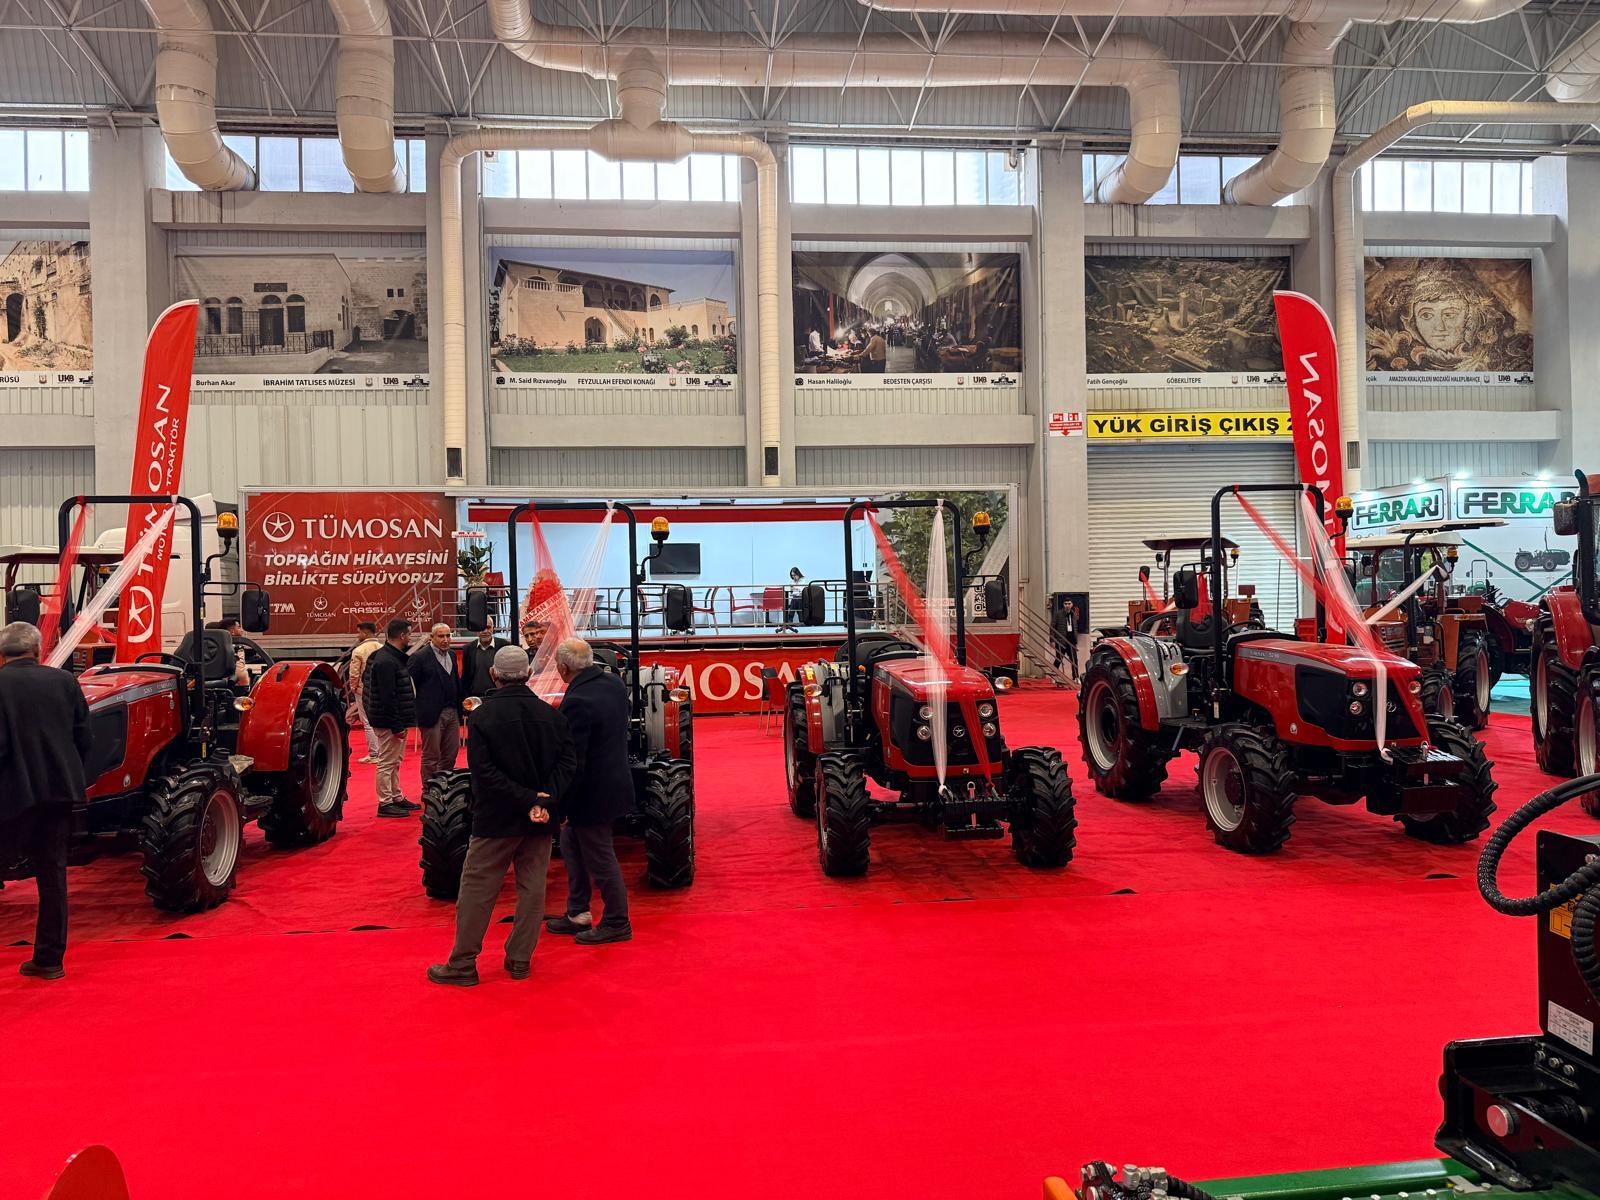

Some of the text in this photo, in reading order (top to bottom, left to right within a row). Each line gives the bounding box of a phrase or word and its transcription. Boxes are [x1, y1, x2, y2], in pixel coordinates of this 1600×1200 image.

[57, 374, 75, 382] UKB
[263, 378, 293, 386] İBRAHİM
[328, 378, 356, 386] MÜZESİ
[383, 377, 399, 385] UKB
[509, 377, 518, 385] M.
[518, 377, 531, 385] Said
[577, 377, 656, 386] FEYZULLAH EFENDİ KONAĞI
[686, 376, 701, 385] UKB
[972, 376, 988, 384] UKB
[1101, 378, 1128, 386] Gençoğlu
[1166, 376, 1202, 384] GÖBEKLİTEPE
[1246, 375, 1261, 383] UKB
[1497, 374, 1512, 382] UKB
[912, 378, 933, 387] ÇARŞISI
[1094, 415, 1142, 434] YÜK
[1149, 414, 1212, 436] GİRİŞ
[1219, 416, 1280, 435] ÇIKIŞ
[166, 417, 179, 486] TRAKTÖR
[1356, 494, 1439, 526] FERRARI
[301, 514, 443, 539] TÜMOSAN
[264, 549, 449, 567] TOPRAĞIN HİKAYESİNİ
[264, 570, 445, 586] BİRLİKTE SÜRÜYORUZ
[342, 606, 397, 614] CRASSUS
